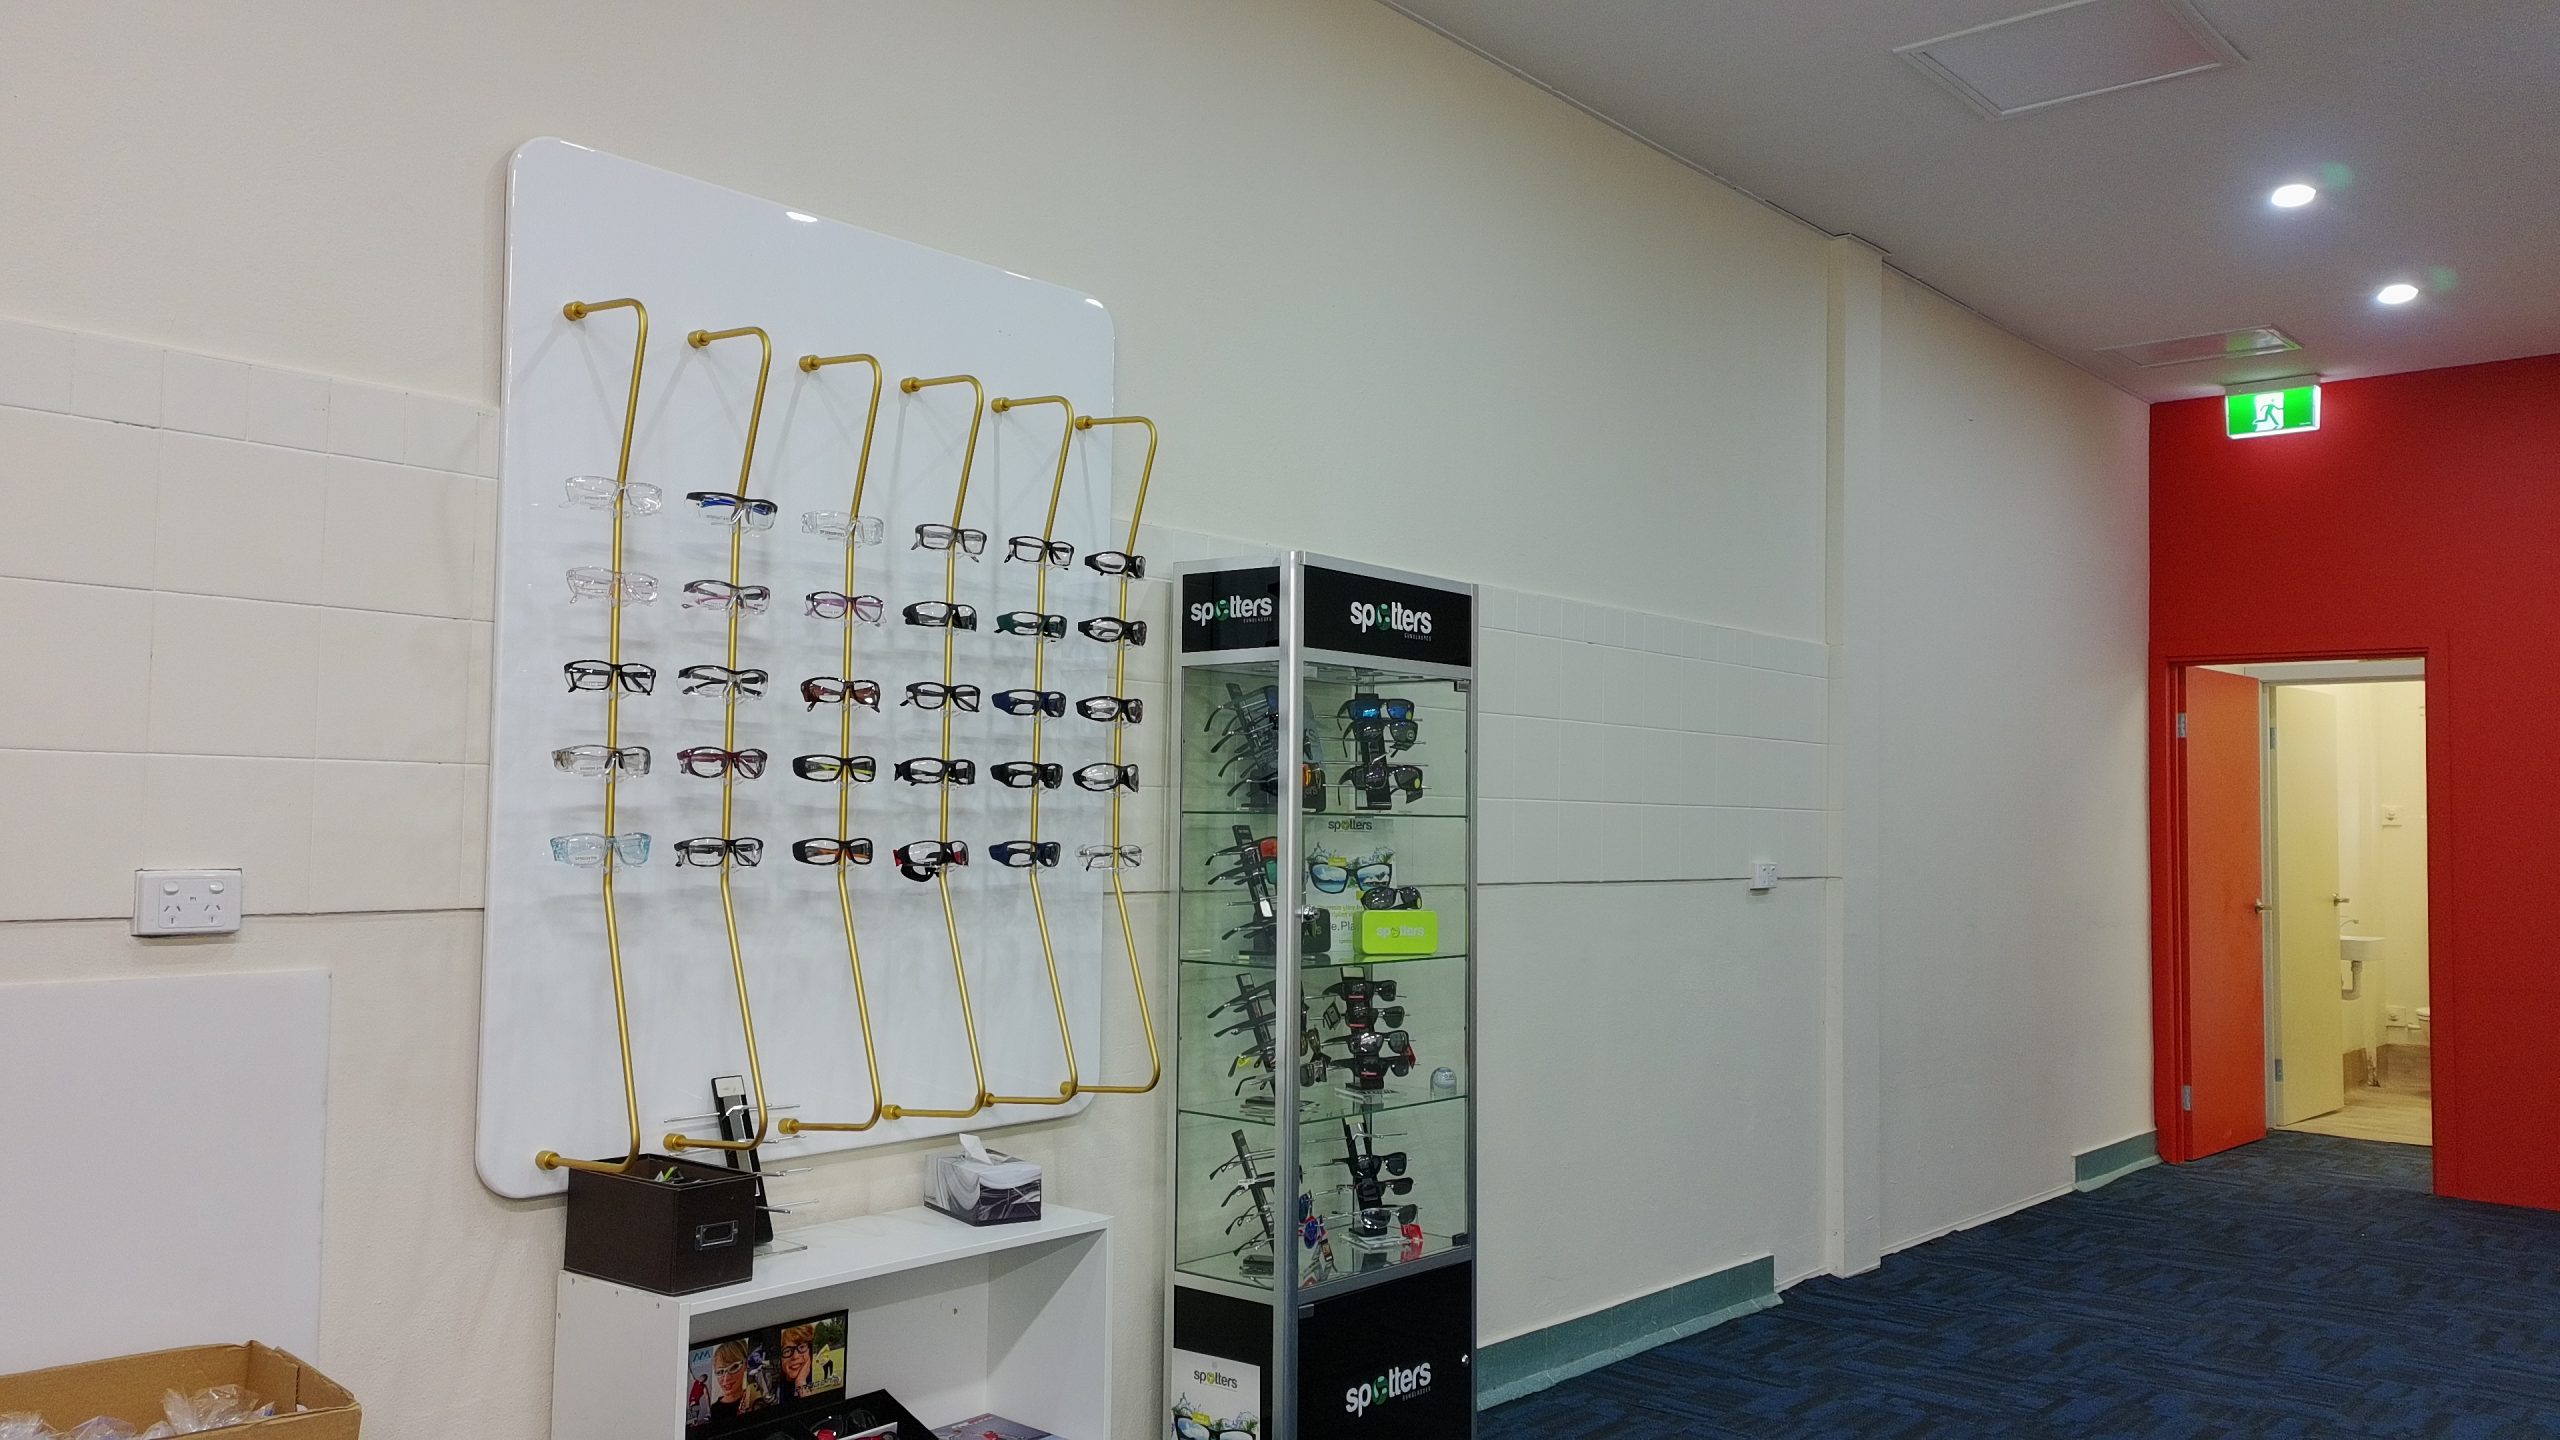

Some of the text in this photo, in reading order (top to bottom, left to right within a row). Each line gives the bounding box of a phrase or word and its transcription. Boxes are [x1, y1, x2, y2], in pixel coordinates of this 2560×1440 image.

[1190, 595, 1273, 627] spotters
[1350, 601, 1432, 633] spotters
[1345, 1362, 1432, 1418] spotters
